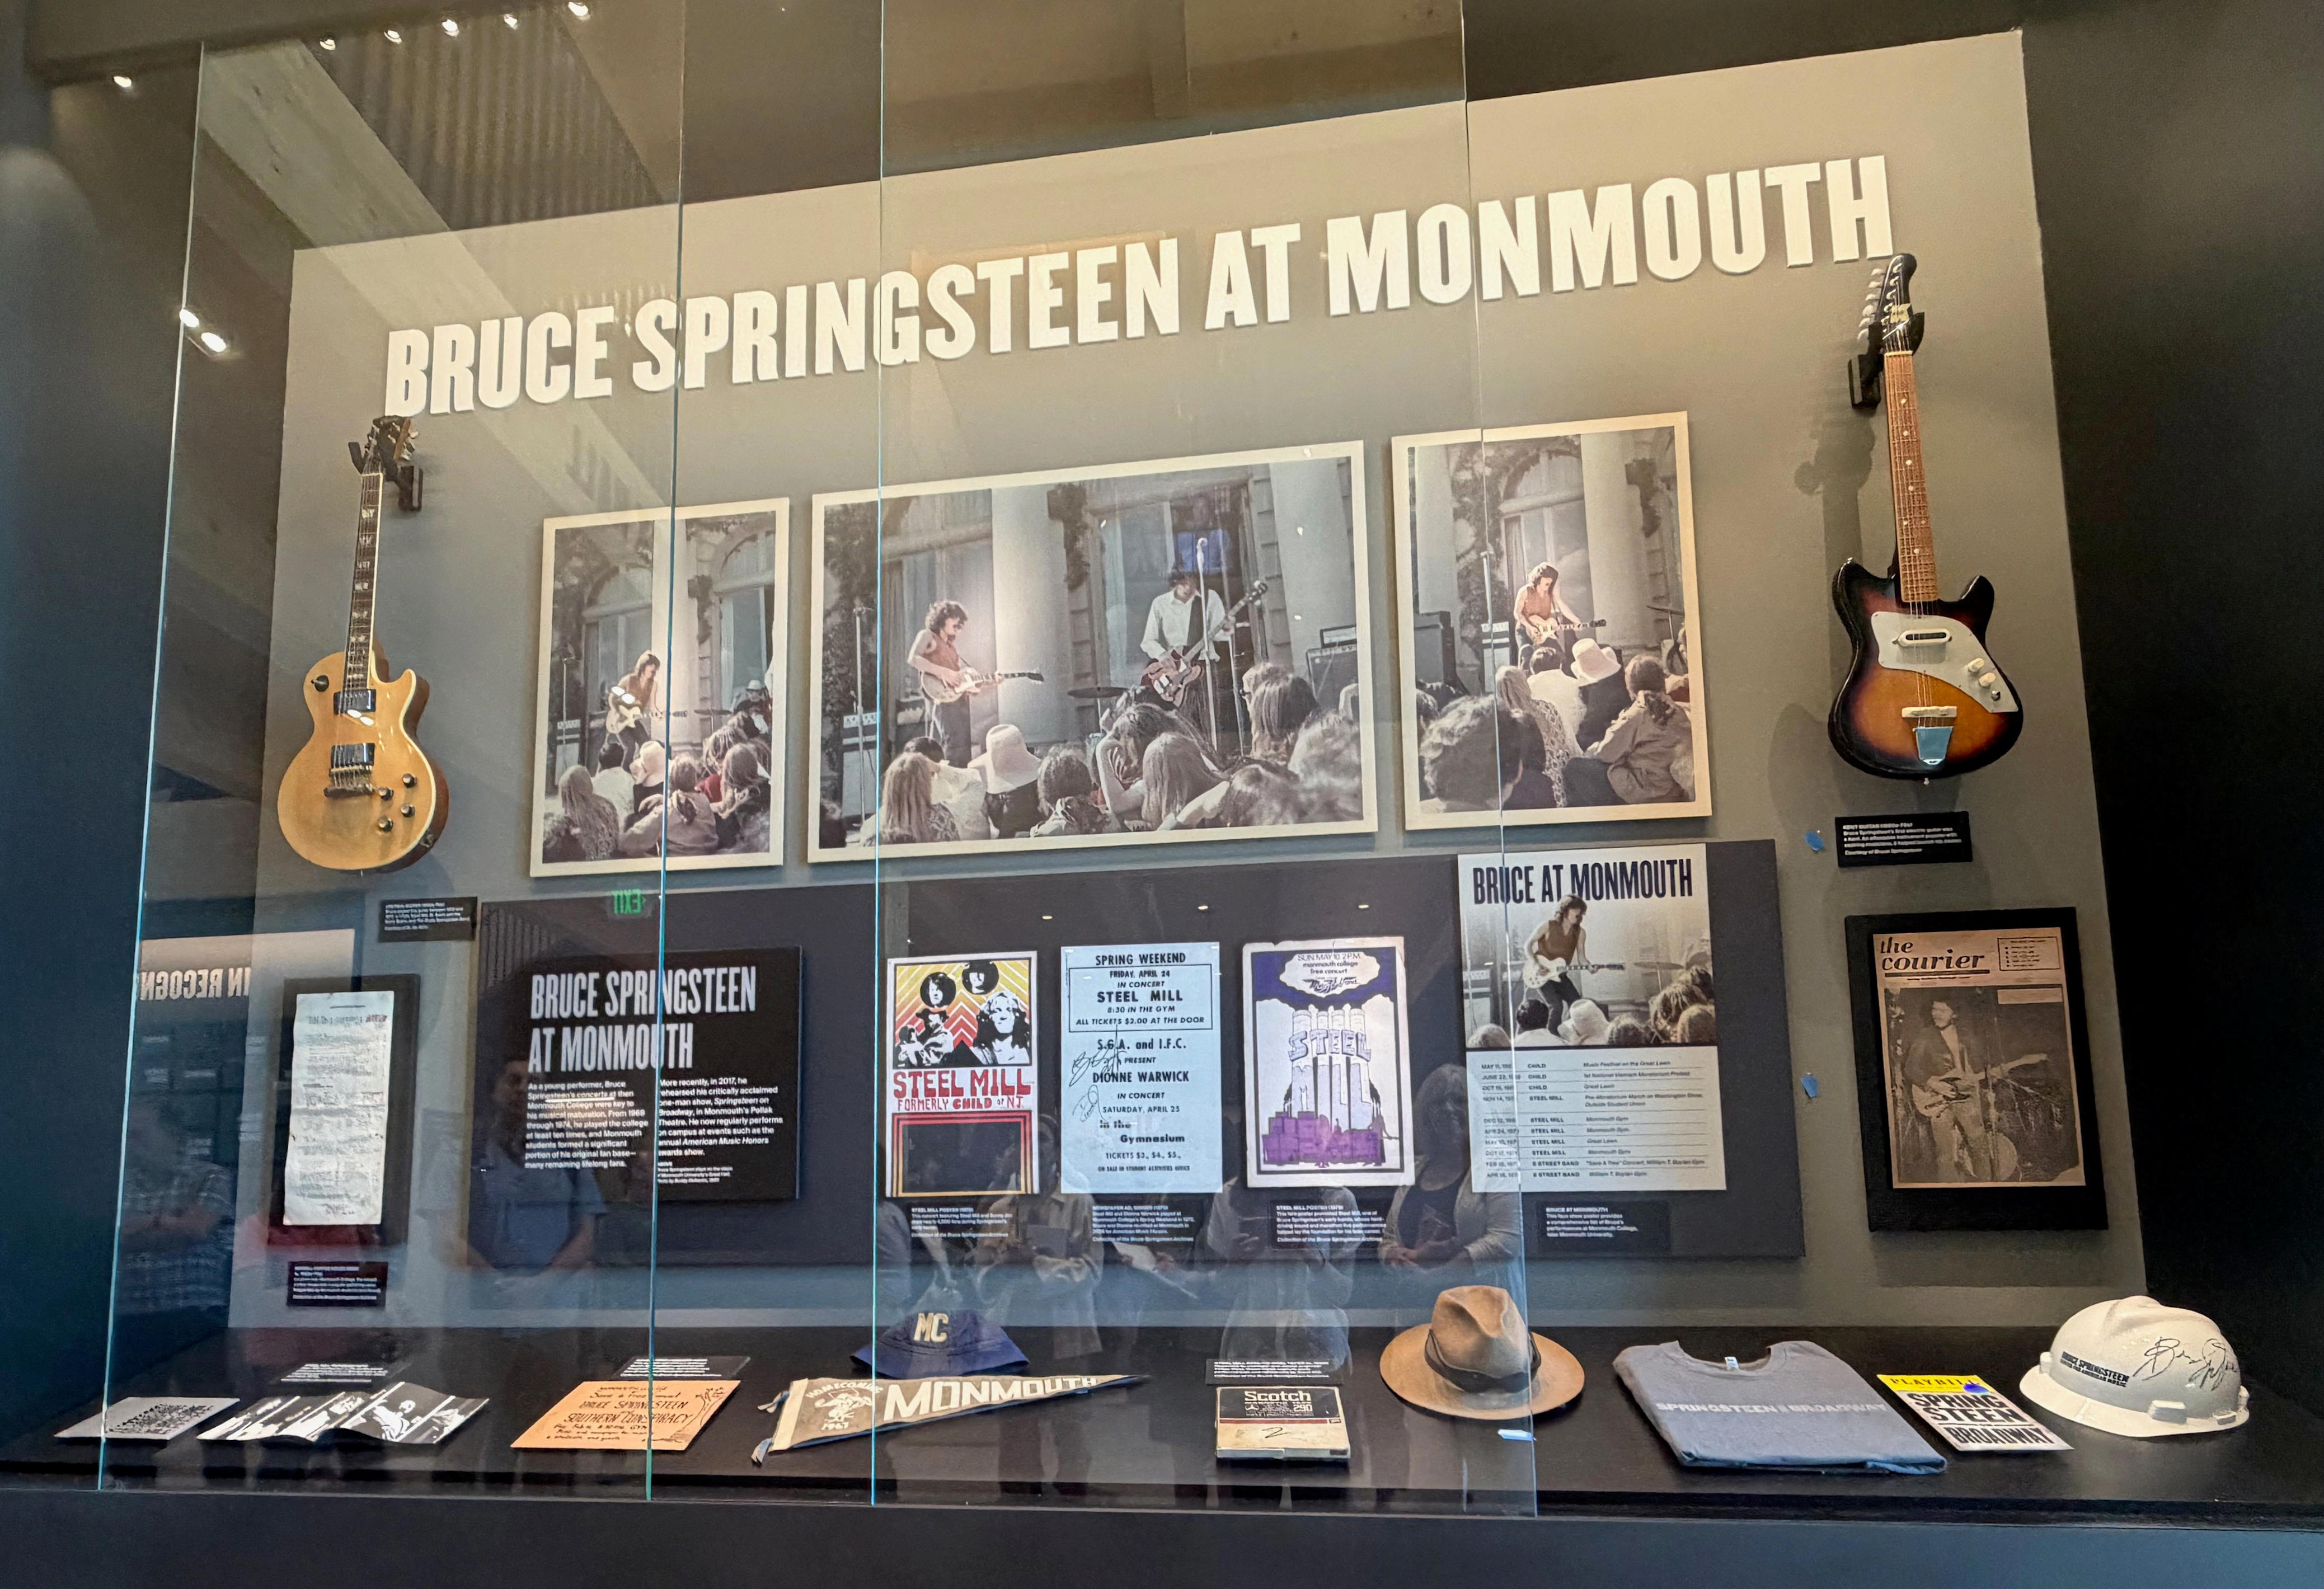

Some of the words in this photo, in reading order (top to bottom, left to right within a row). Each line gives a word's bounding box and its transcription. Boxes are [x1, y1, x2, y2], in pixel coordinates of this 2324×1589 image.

[384, 305, 616, 417] BRUCE
[633, 238, 1179, 393] SPRINGSTEEN
[1205, 223, 1300, 330] AT
[1327, 155, 1894, 317] MONMOUTH
[1472, 866, 1535, 905] BRUCE
[1542, 864, 1564, 902] AT
[1570, 859, 1693, 901] MONMOUTH
[1880, 937, 1913, 953] the
[1096, 955, 1133, 965] SPRING
[1139, 953, 1186, 963] WEEKEND
[1882, 949, 1985, 971] courier
[530, 972, 599, 1019] BRUCE
[605, 966, 757, 1016] SPRINGSTEEN
[1097, 991, 1138, 1003] STEEL
[1151, 990, 1183, 1002] MILL
[528, 1027, 555, 1073] AT
[561, 1023, 693, 1071] MONMOUTH
[1136, 1038, 1153, 1049] and
[1159, 1038, 1186, 1049] I.F.C.
[1288, 1029, 1372, 1062] STEEL
[894, 1070, 964, 1098] STEEL
[970, 1068, 1031, 1097] MILL
[1093, 1072, 1132, 1083] DIONNE
[1138, 1071, 1189, 1082] WARWICK
[898, 1098, 949, 1111] FORMERLY
[952, 1098, 992, 1109] CHILD
[1292, 1063, 1373, 1130] MILL
[584, 1120, 607, 1129] played
[1120, 1134, 1185, 1144] Gymnasium
[572, 1150, 598, 1159] original
[914, 1313, 949, 1343] MC
[805, 1382, 883, 1398] HOMECOMING
[884, 1375, 1098, 1421] MONMOUTH
[1245, 1390, 1311, 1401] Scotch
[1656, 1402, 1779, 1414] SPRINGSTEEN
[1907, 1393, 2010, 1409] SPRING
[1923, 1407, 2028, 1423] STEEN
[821, 1422, 849, 1430] 1967
[1943, 1427, 2055, 1444] BROADWAY
